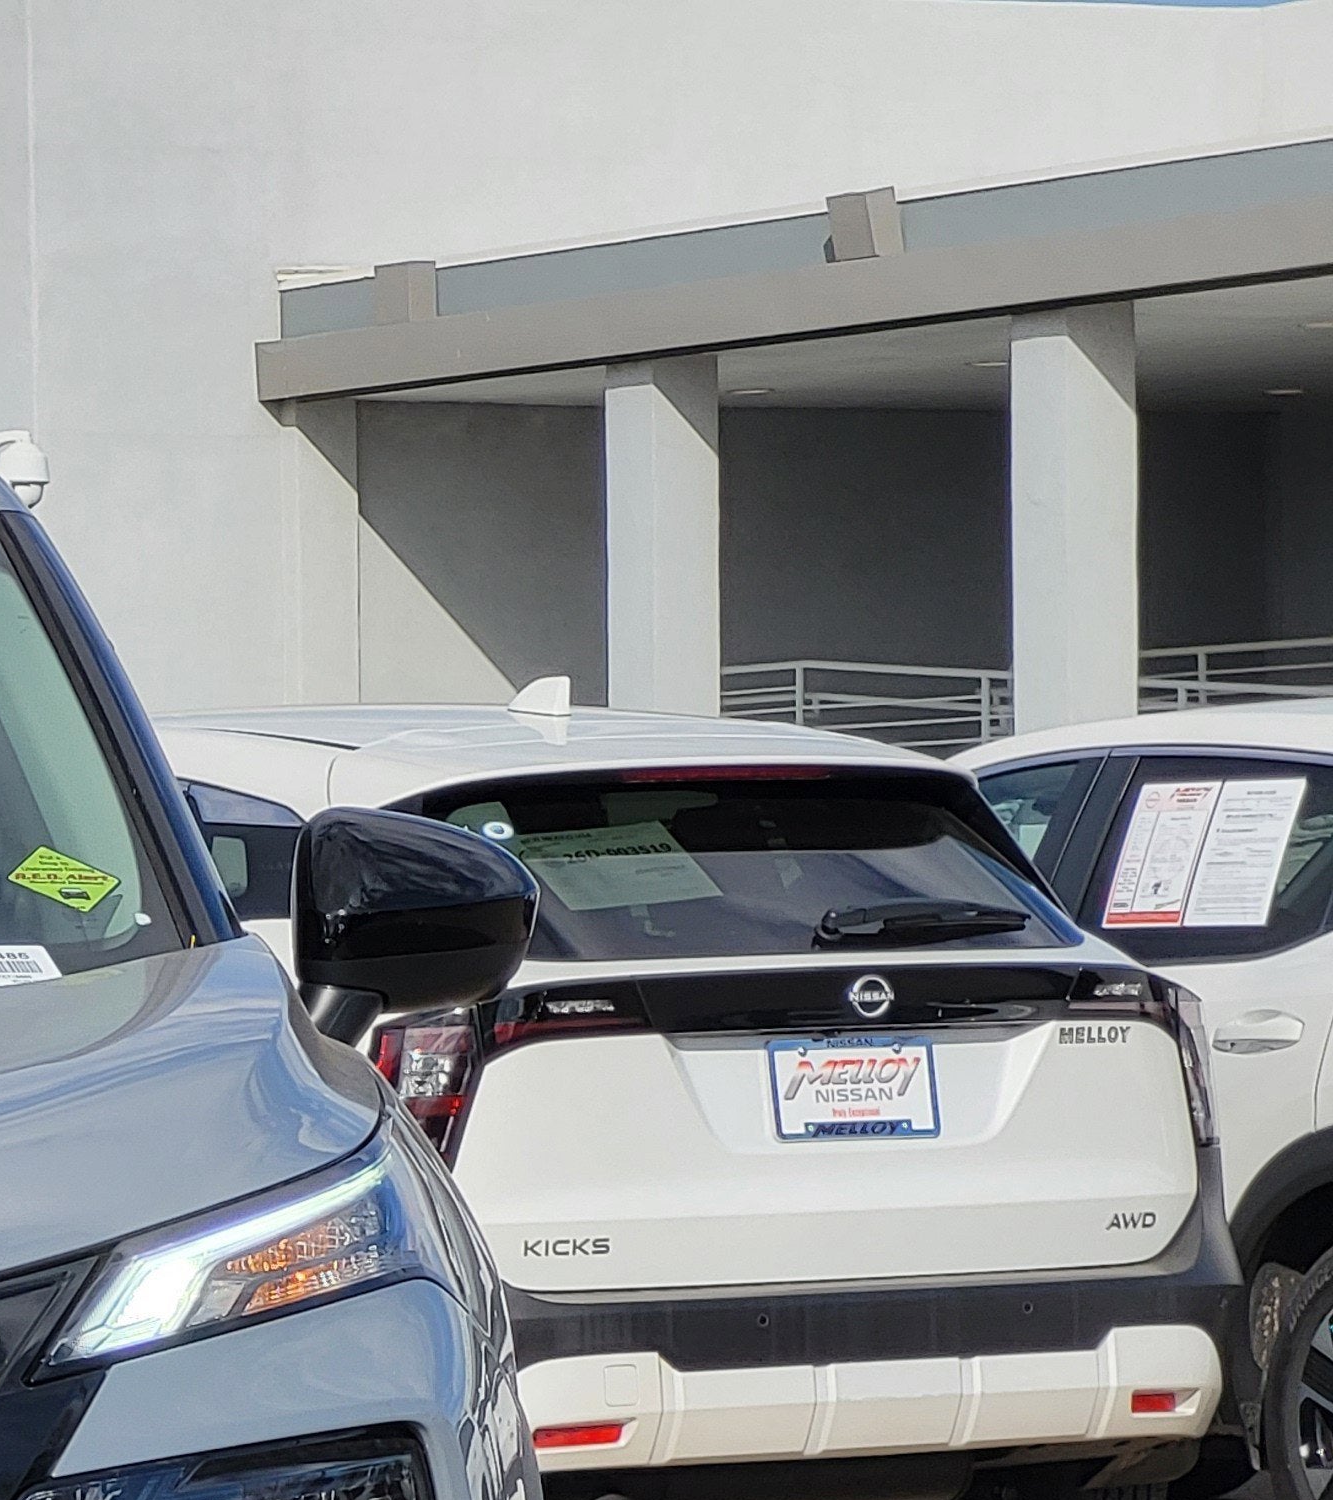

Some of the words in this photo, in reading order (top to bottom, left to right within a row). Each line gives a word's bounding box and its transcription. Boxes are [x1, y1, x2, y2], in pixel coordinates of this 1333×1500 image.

[849, 991, 895, 1001] NISSAN
[826, 1038, 874, 1047] NISSAN
[1059, 1026, 1131, 1044] MELLOY
[784, 1057, 921, 1100] MELLOY
[815, 1087, 893, 1103] NISSAN
[813, 1120, 899, 1138] MELLOY
[1106, 1212, 1157, 1230] AWD
[524, 1238, 611, 1257] KICKS
